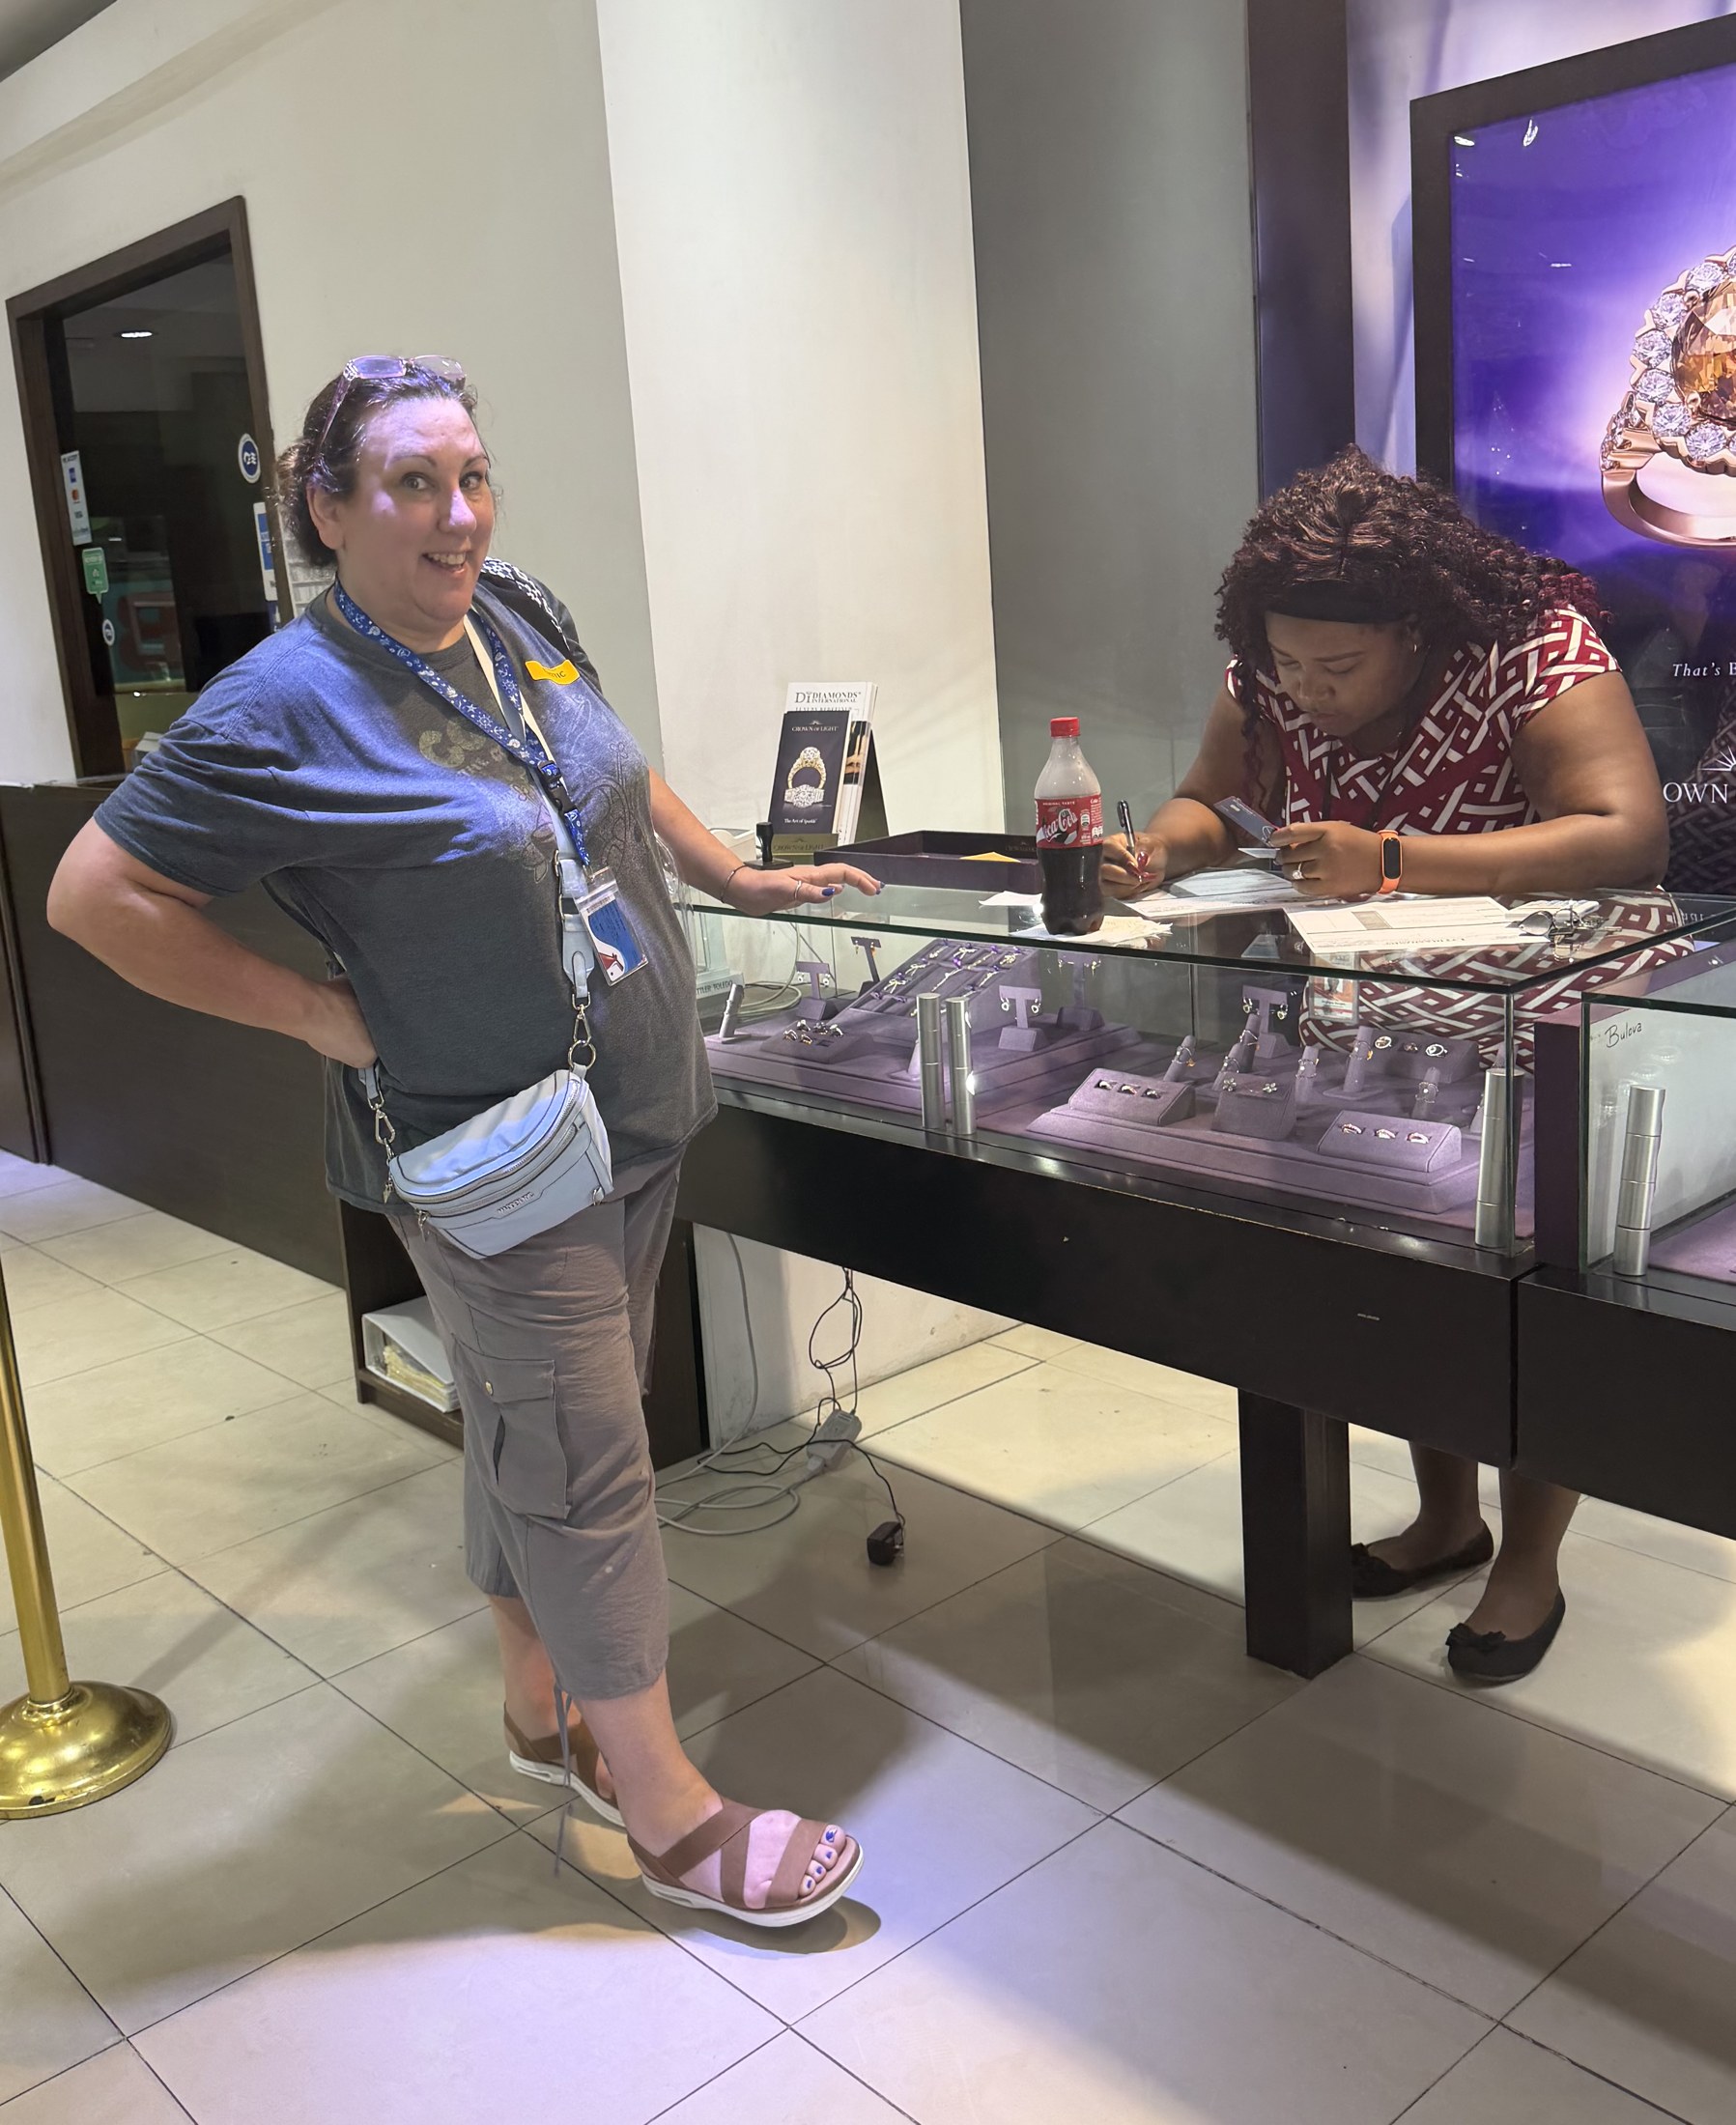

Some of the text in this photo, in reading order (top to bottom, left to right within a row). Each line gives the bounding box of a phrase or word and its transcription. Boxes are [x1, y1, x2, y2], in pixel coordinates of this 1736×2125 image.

[1672, 662, 1721, 676] That's
[1663, 781, 1728, 804] OWN
[697, 984, 711, 995] TTLER
[1605, 1021, 1642, 1048] Bulova
